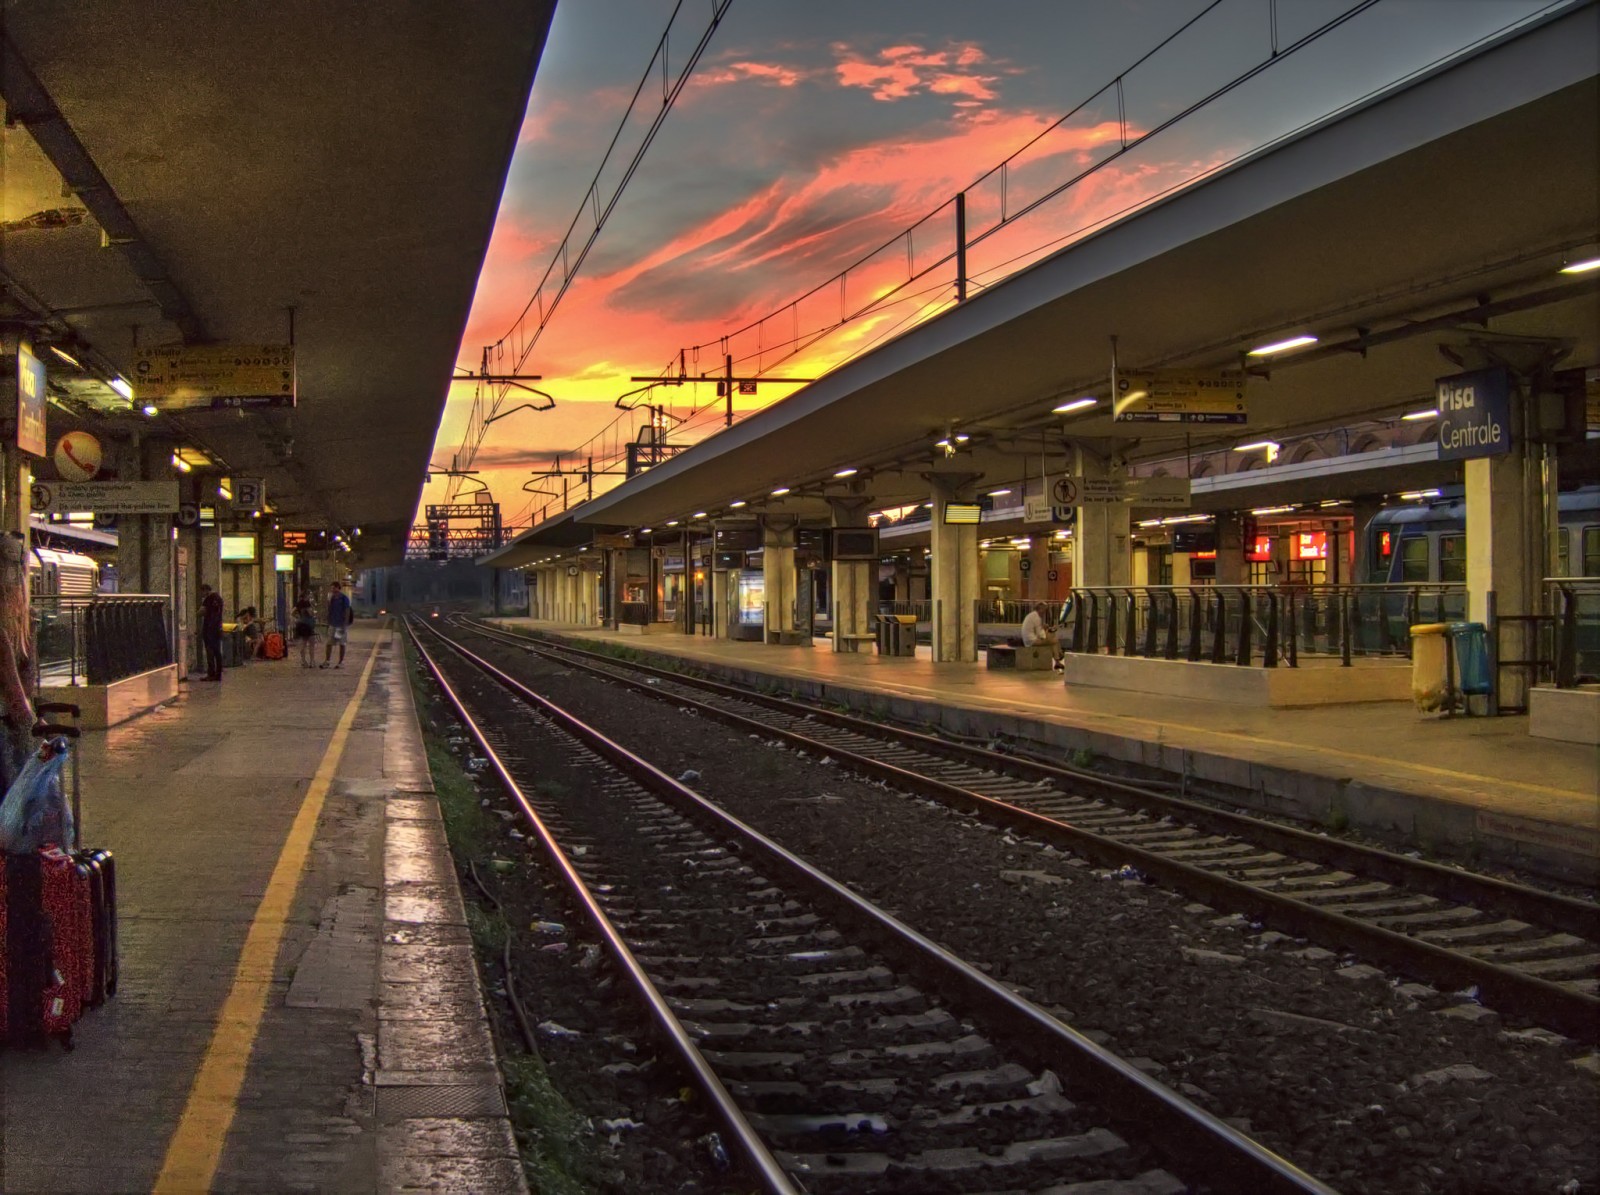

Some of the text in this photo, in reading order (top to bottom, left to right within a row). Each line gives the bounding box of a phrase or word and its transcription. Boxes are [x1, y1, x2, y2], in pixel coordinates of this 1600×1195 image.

[1439, 382, 1475, 412] Pisa
[1440, 412, 1501, 450] Centrale
[239, 484, 258, 505] B
[1151, 496, 1172, 504] yellow
